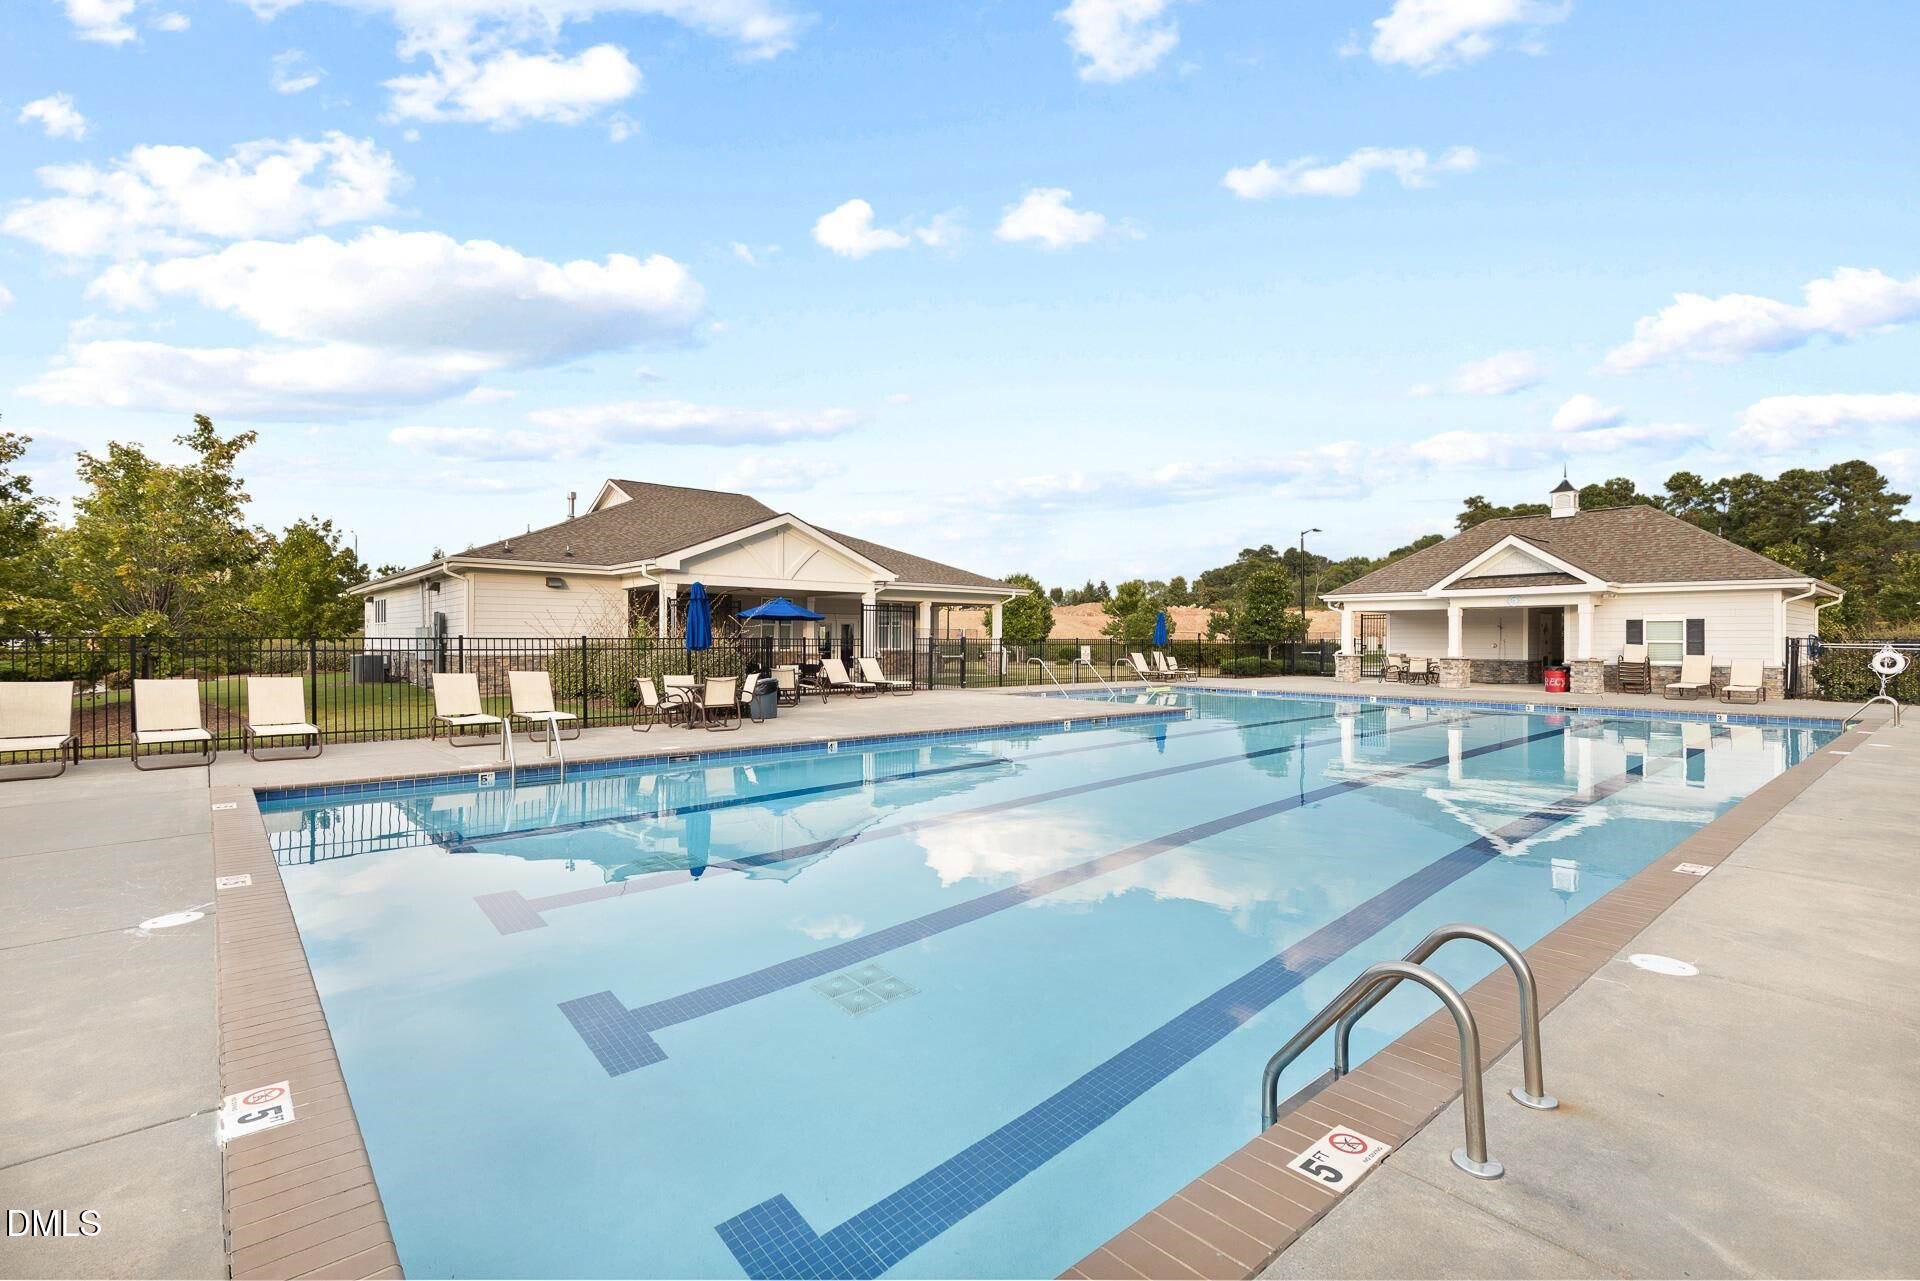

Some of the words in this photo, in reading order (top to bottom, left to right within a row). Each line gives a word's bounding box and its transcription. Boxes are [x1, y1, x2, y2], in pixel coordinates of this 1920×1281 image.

[237, 1105, 283, 1124] 5
[1312, 1150, 1331, 1163] FT
[1298, 1158, 1344, 1183] 5
